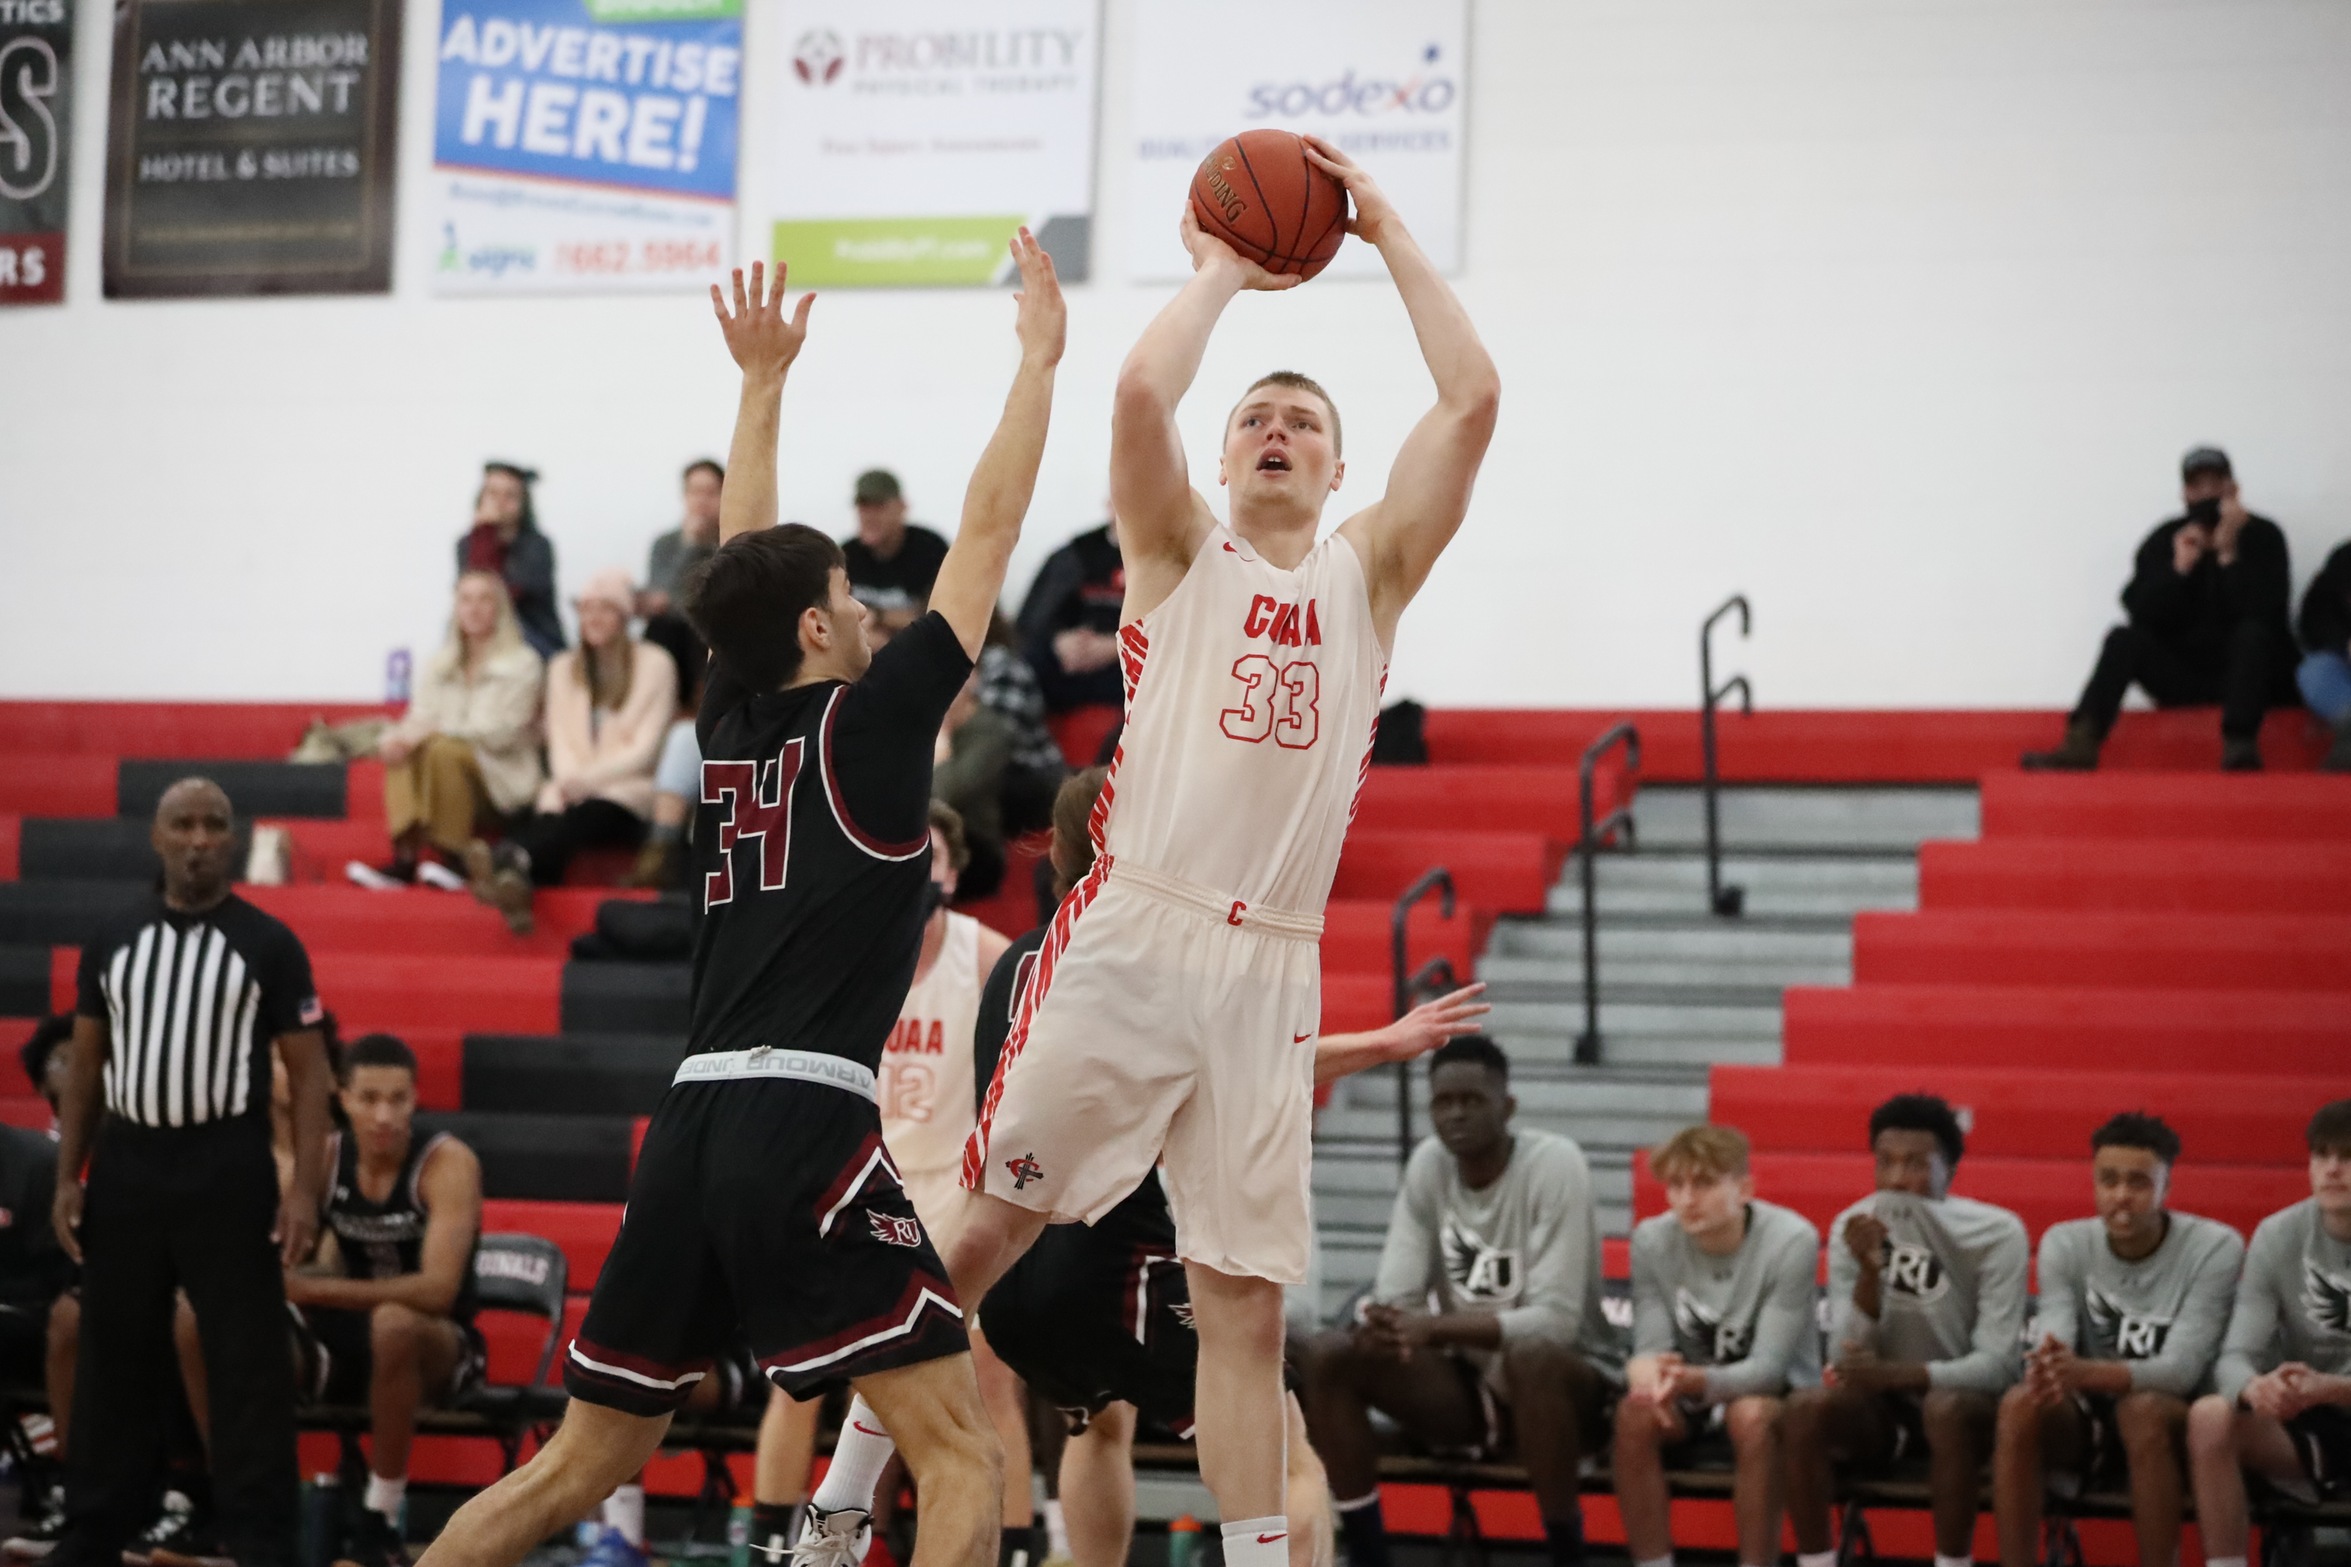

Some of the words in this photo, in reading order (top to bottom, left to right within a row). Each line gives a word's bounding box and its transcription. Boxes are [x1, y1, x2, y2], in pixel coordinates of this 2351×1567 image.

[141, 42, 226, 73] ANN
[233, 33, 368, 69] ARBOR
[442, 15, 738, 95] ADVERTISE
[857, 30, 1083, 70] PROBILITY
[146, 70, 362, 119] REGENT
[1248, 68, 1455, 118] sodexo
[461, 76, 707, 172] HERE!
[140, 153, 230, 181] HOTEL
[236, 149, 257, 181] &
[263, 148, 359, 178] SUITES
[1219, 654, 1319, 750] 33
[701, 735, 805, 915] 34
